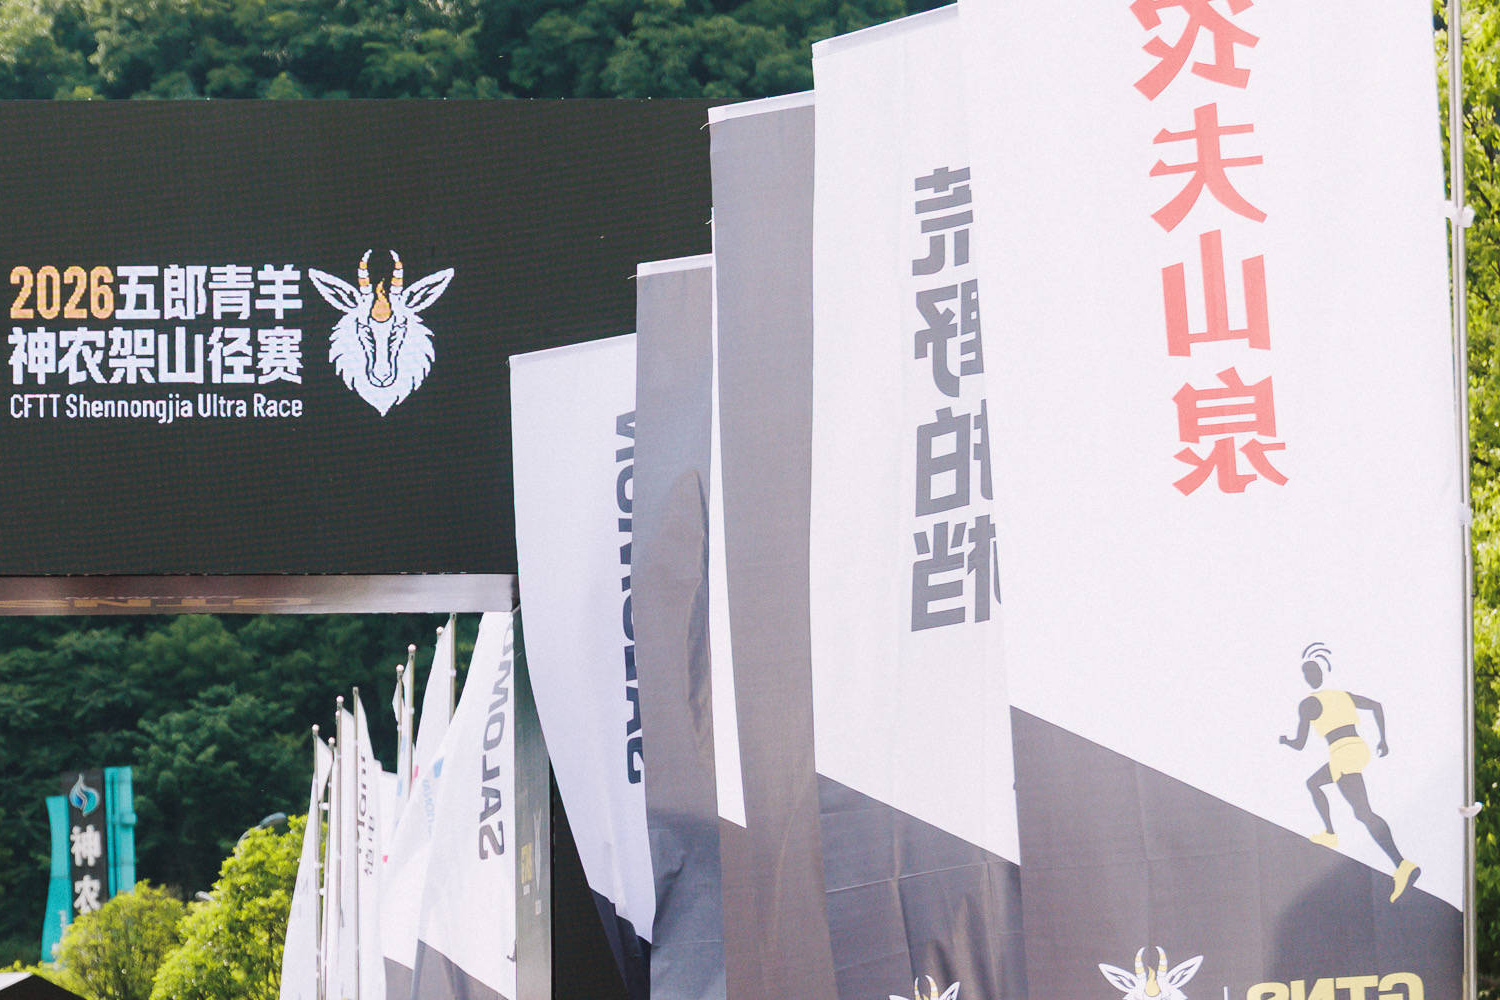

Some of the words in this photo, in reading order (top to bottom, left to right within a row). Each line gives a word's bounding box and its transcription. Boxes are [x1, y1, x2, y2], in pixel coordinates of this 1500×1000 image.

[8, 264, 304, 320] 2026五郎青羊
[8, 327, 304, 387] 神农架山径赛
[10, 394, 62, 418] CFTT
[65, 393, 192, 424] Shennongjia
[197, 393, 248, 418] Ultra
[253, 394, 304, 418] Race
[70, 824, 102, 916] 神农
